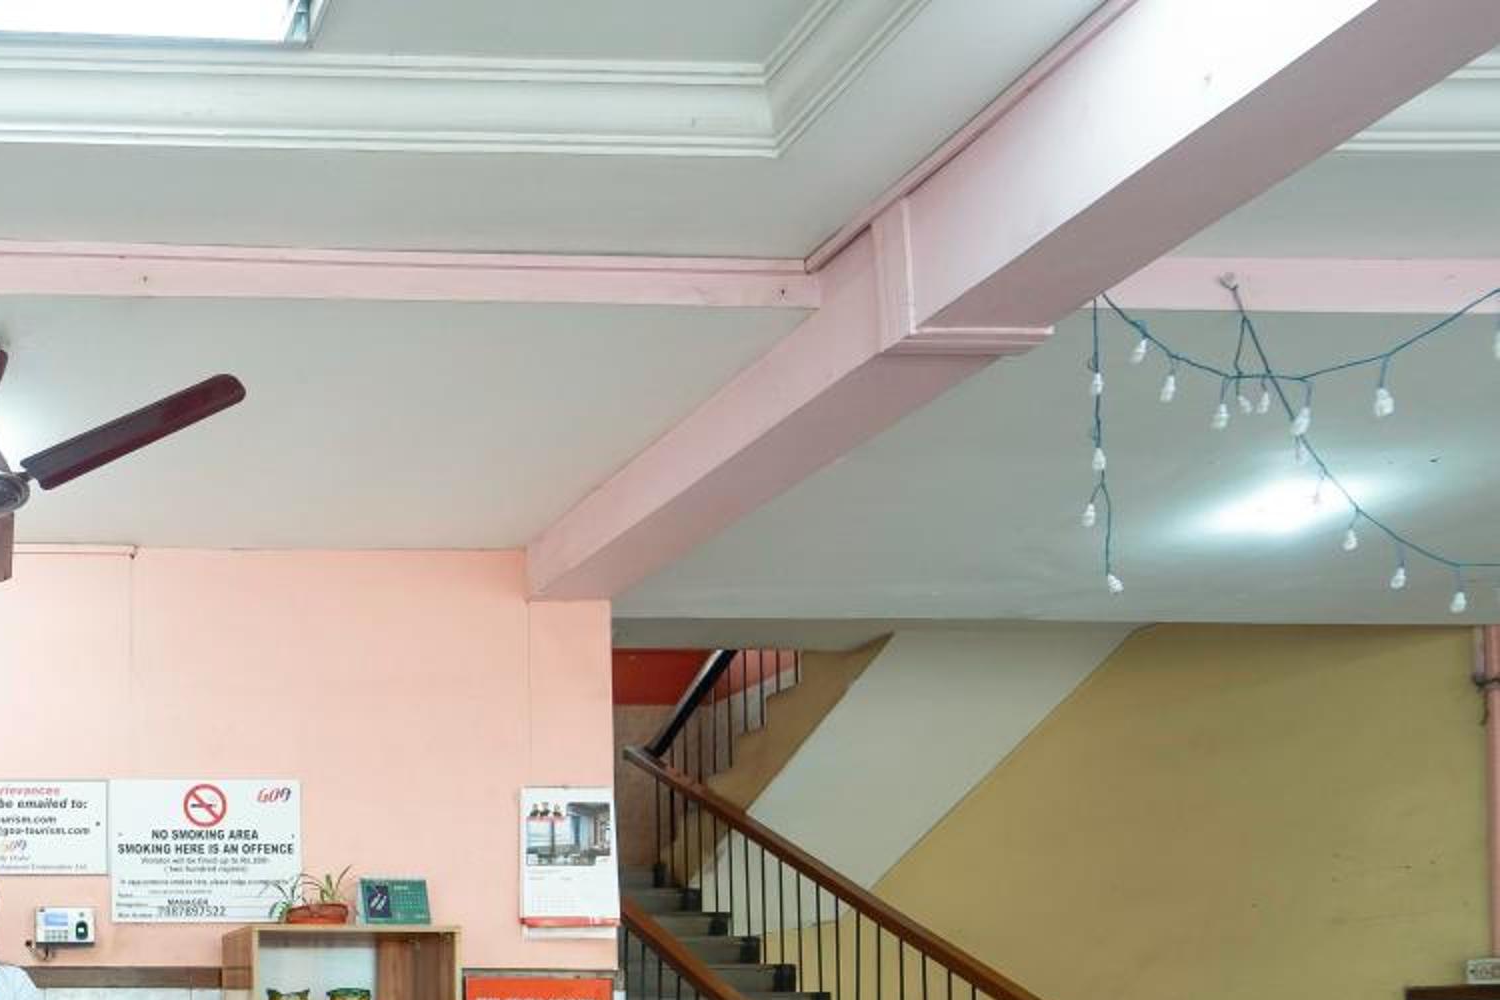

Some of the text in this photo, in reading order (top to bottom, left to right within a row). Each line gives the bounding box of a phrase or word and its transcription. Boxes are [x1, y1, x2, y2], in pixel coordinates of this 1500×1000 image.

[17, 798, 67, 809] emailed
[71, 799, 88, 809] to:
[151, 829, 259, 840] NO SMOKING AREA
[117, 843, 293, 855] SMOKING HERE IS AN OFFENCE
